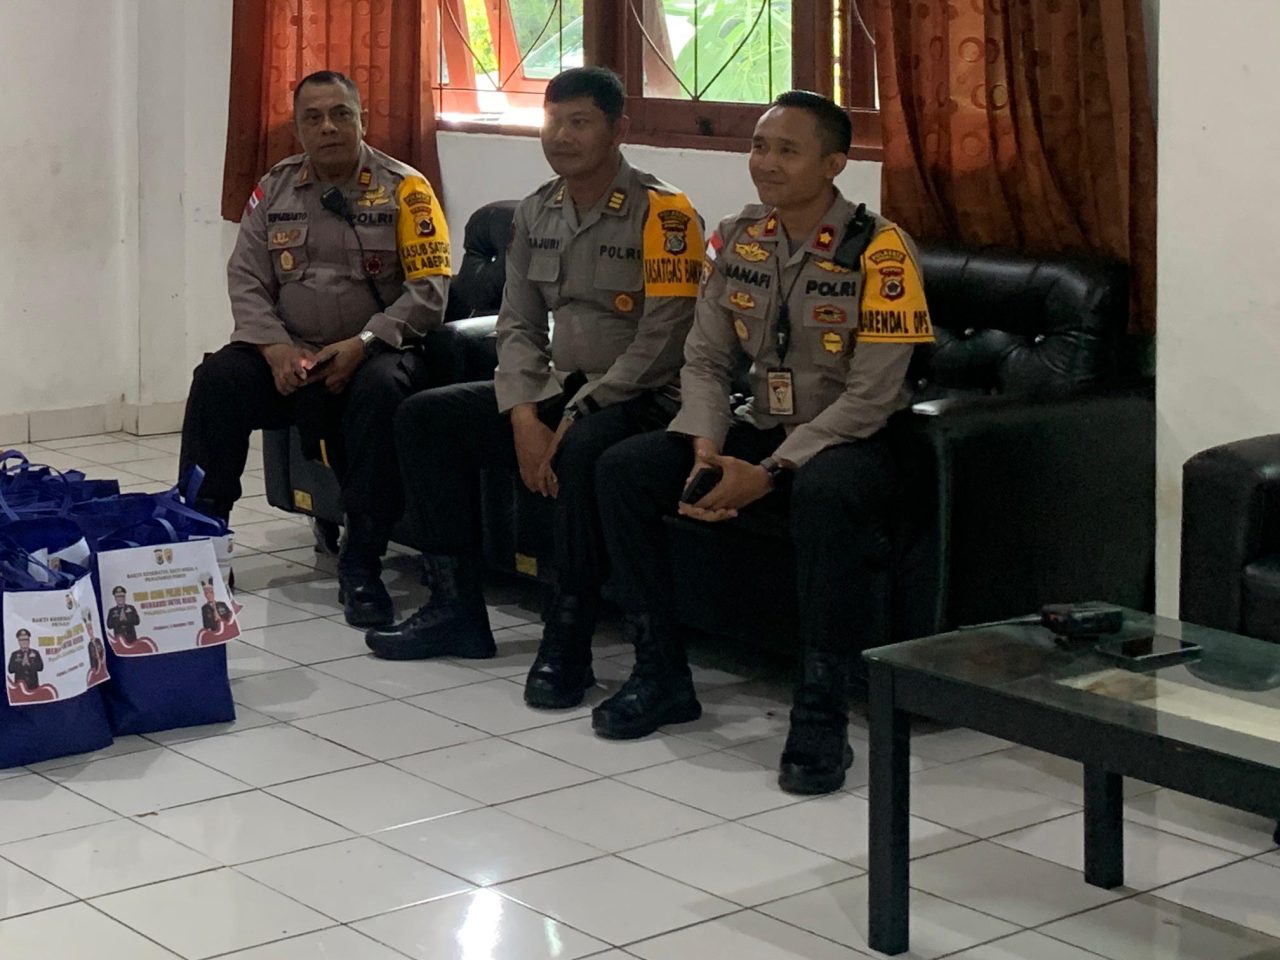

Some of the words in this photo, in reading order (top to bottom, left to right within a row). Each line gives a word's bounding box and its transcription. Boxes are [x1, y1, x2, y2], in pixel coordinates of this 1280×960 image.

[351, 212, 393, 225] POLRI
[600, 245, 641, 260] POLRI
[805, 279, 856, 297] POLRI
